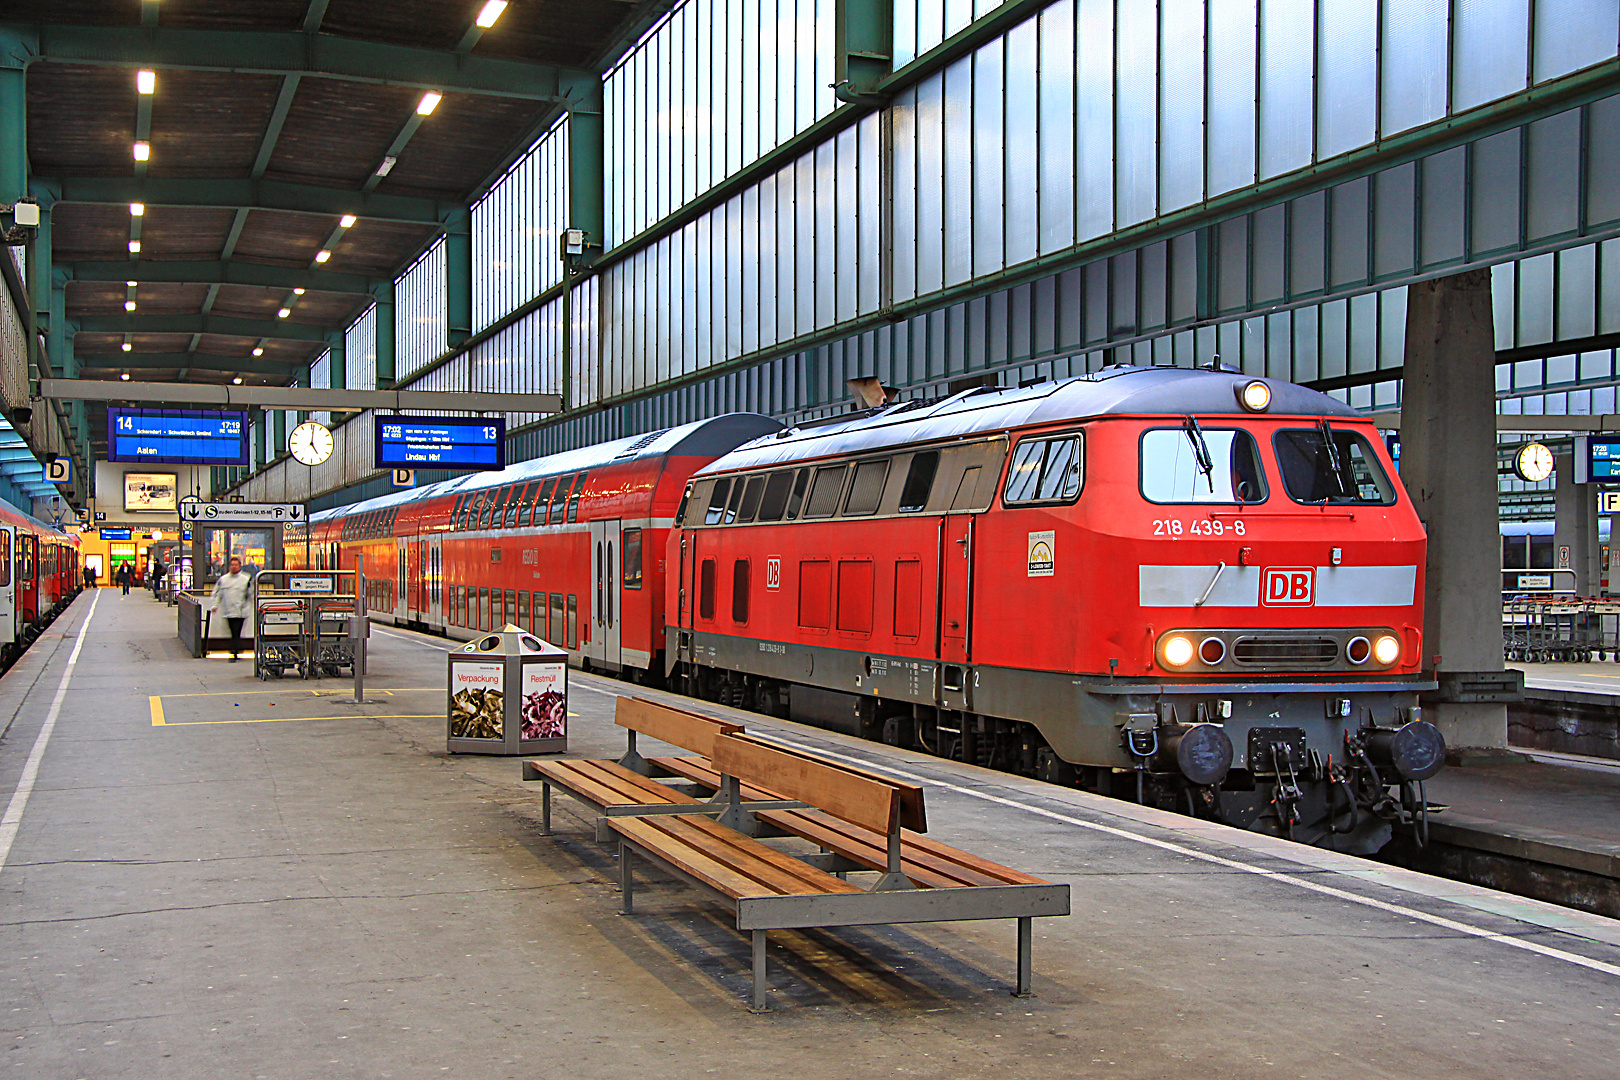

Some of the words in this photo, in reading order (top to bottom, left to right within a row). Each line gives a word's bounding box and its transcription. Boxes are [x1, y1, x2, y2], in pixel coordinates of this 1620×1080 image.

[117, 416, 133, 430] 14
[221, 421, 241, 429] 17:19
[382, 425, 402, 433] 17:02
[482, 426, 497, 440] 13
[136, 446, 158, 455] Aalen
[405, 453, 427, 461] Lindau
[428, 453, 441, 461] Hbf
[51, 462, 64, 478] D
[397, 469, 410, 483] D
[1608, 494, 1618, 510] F
[96, 512, 104, 520] 14
[206, 506, 218, 518] S
[1152, 519, 1184, 536] 218
[1190, 519, 1247, 536] 439-8
[768, 561, 779, 585] DB
[1269, 573, 1309, 600] DB
[457, 673, 499, 685] Verpackung
[530, 674, 556, 683] Restmüll
[974, 671, 980, 688] 2
